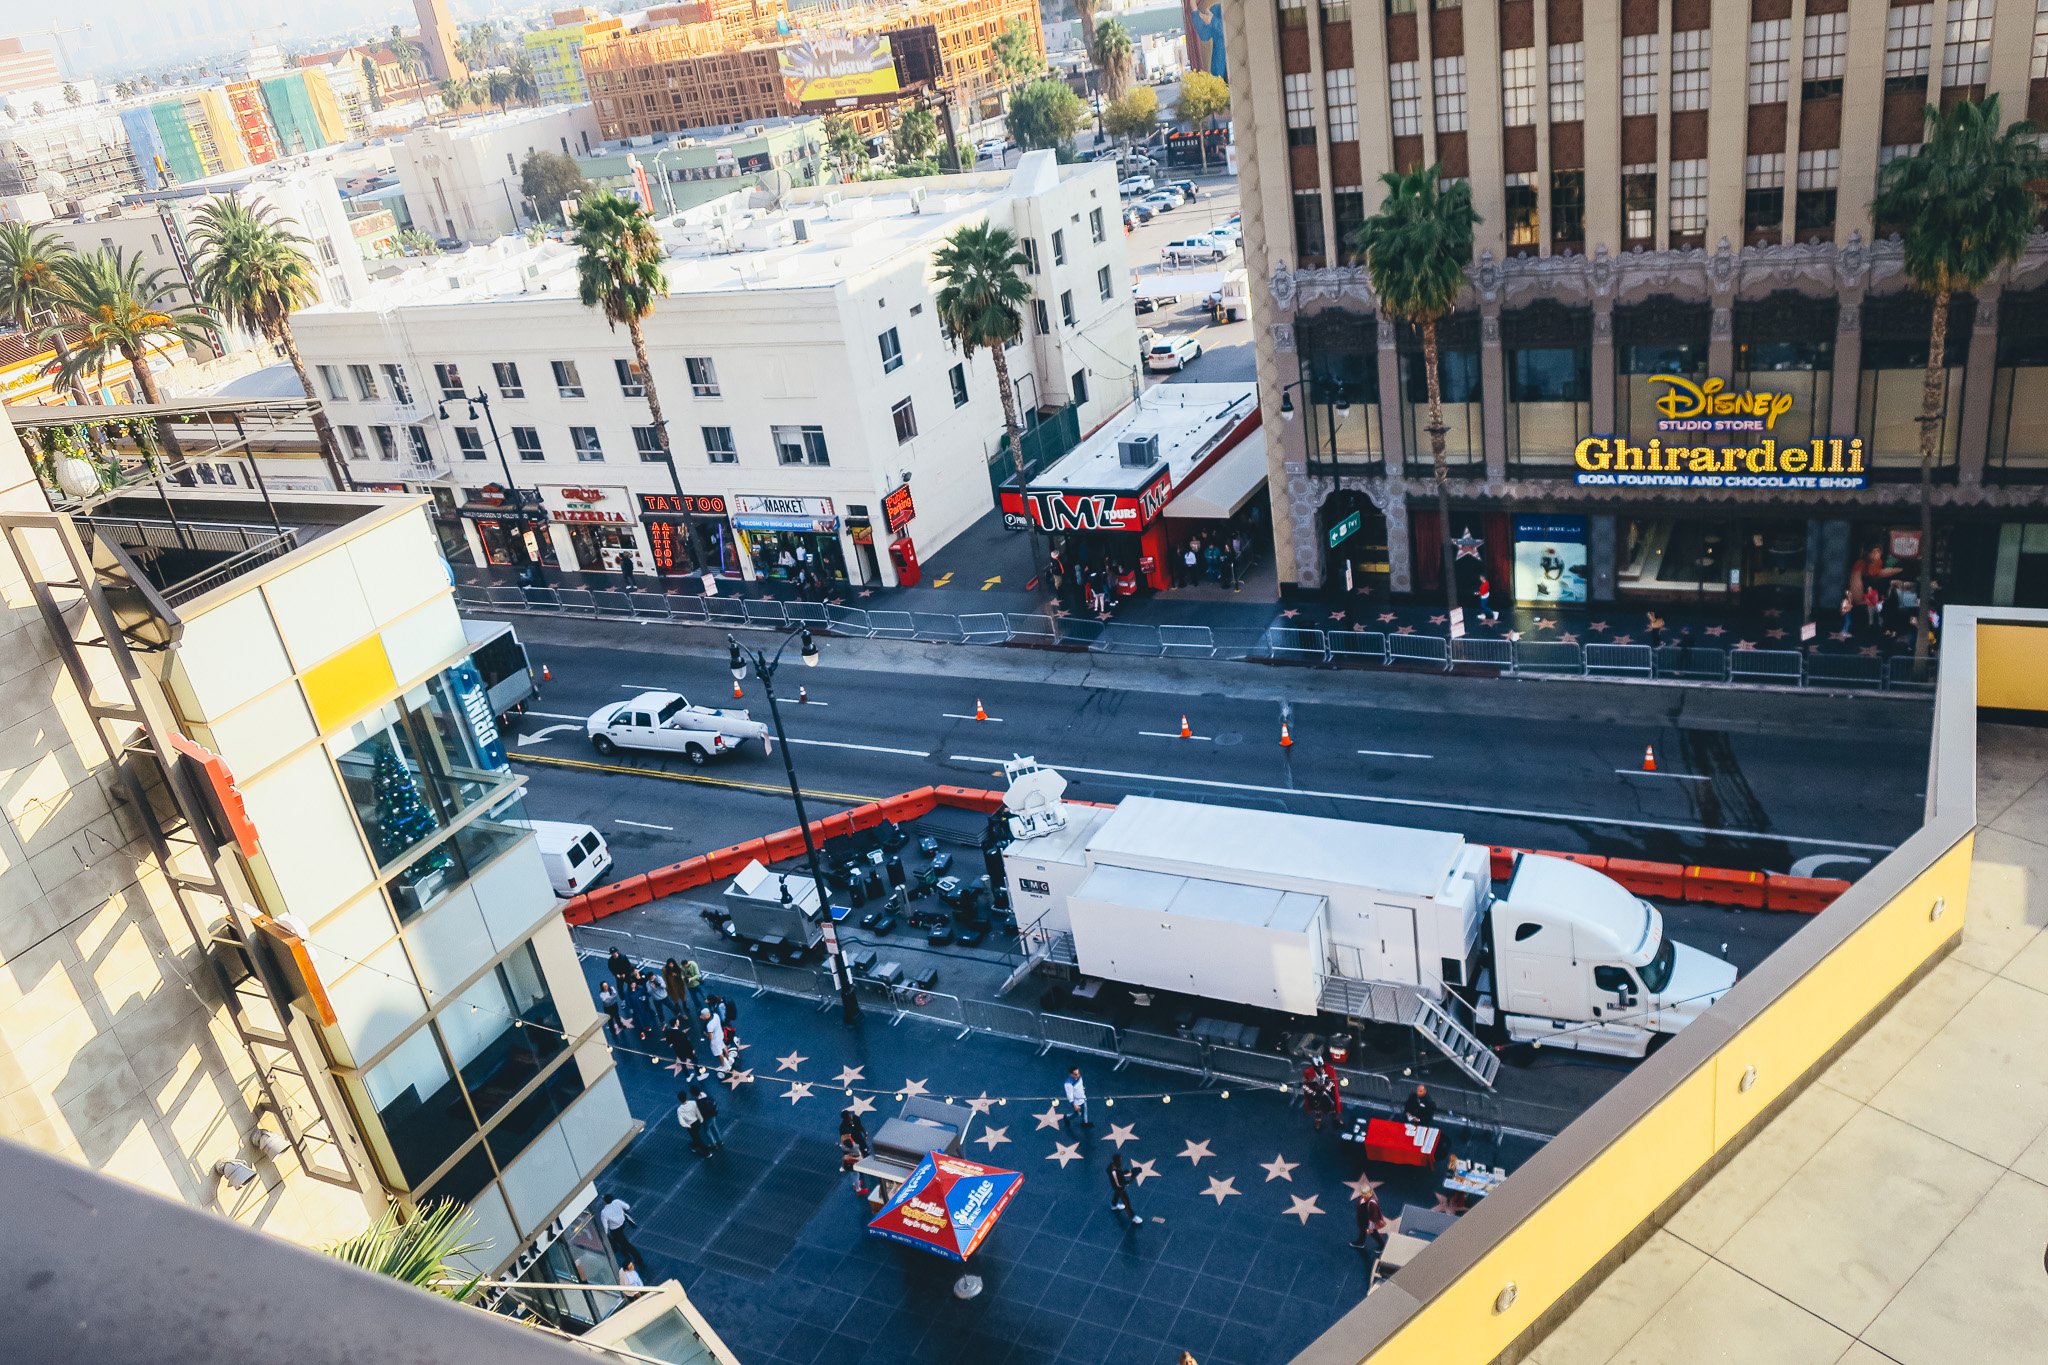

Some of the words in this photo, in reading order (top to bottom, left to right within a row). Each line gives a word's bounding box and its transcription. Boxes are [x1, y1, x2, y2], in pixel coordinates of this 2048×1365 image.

[802, 63, 828, 79] WAX
[829, 60, 874, 78] MUSEUM
[1659, 420, 1712, 431] STUDIO
[1715, 420, 1764, 431] STORE
[1575, 437, 1864, 473] Ghirardelli
[1577, 474, 1616, 485] SODA
[1618, 475, 1689, 486] FOUNTAIN
[1691, 475, 1723, 486] AND
[1725, 476, 1818, 488] CHOCOLATE
[1819, 477, 1863, 488] SHOP
[644, 496, 724, 512] TATTOO
[764, 499, 804, 513] MARKET
[887, 489, 908, 507] Public
[1139, 479, 1168, 520] TMZ
[552, 511, 626, 522] PIZZERIA
[887, 497, 912, 518] Parking
[1020, 491, 1125, 532] TMZ
[1103, 508, 1138, 520] TOURS
[461, 683, 499, 748] DRINK
[1021, 879, 1048, 891] LMG
[967, 1206, 982, 1226] TOURS
[475, 1239, 541, 1310] OREVER
[546, 1216, 564, 1242] 21
